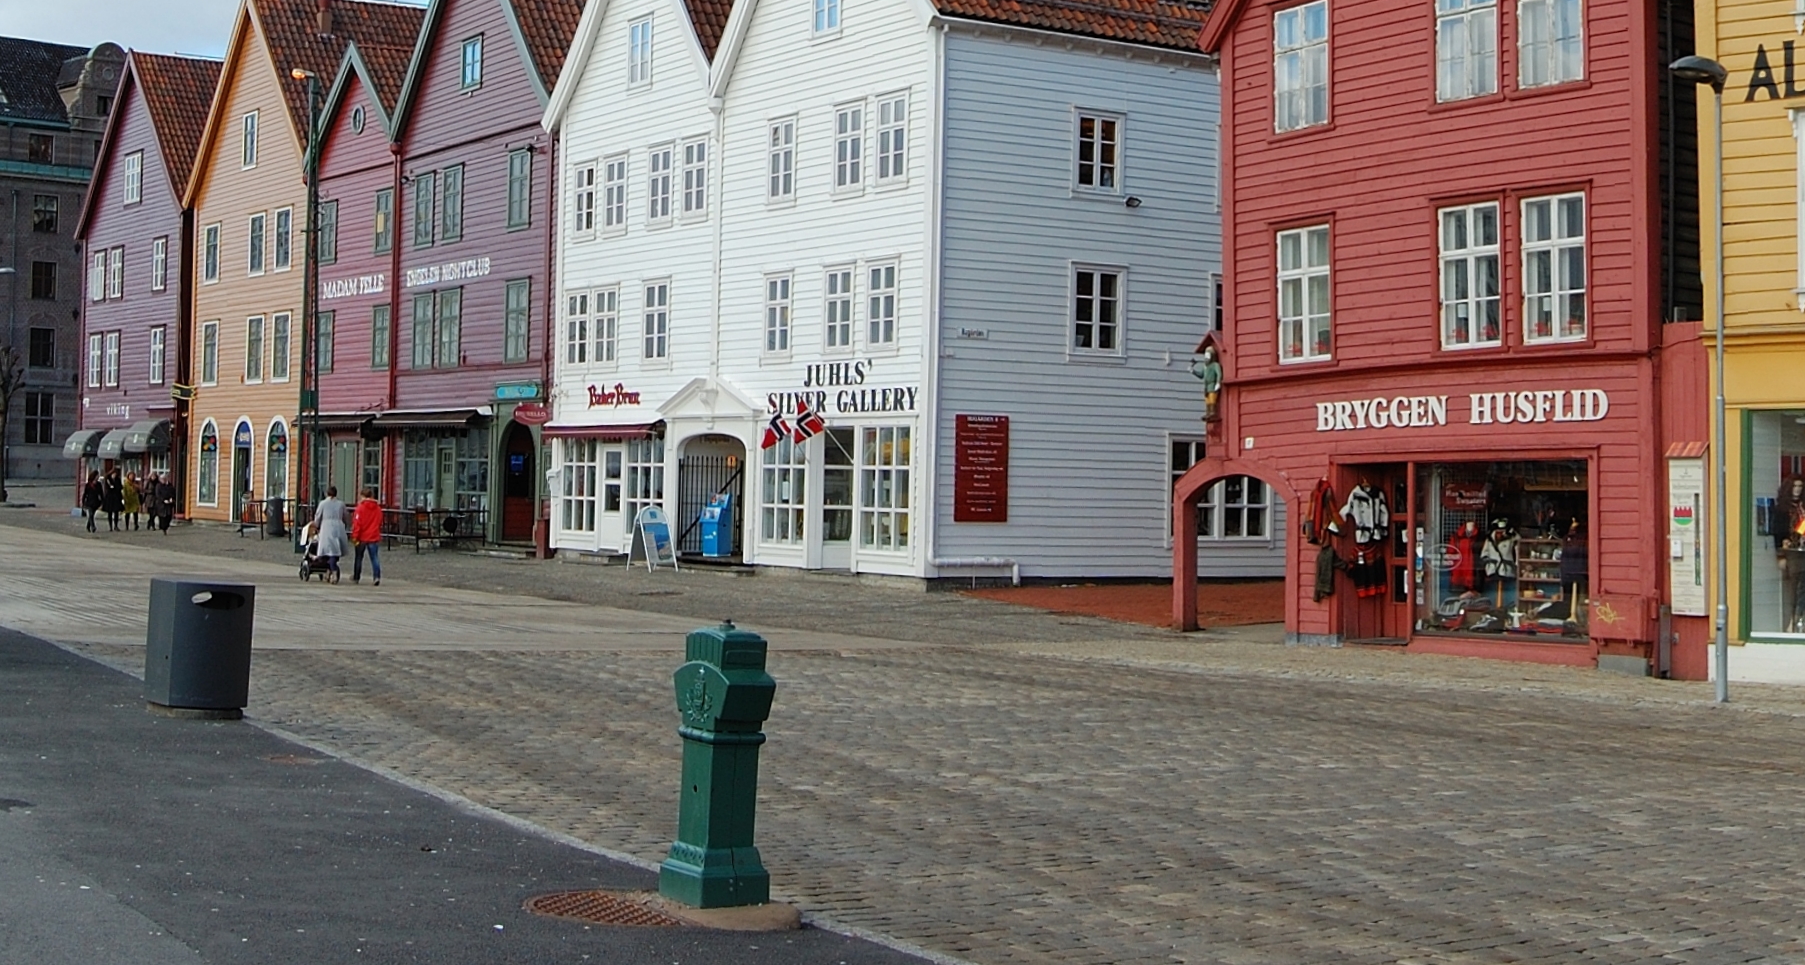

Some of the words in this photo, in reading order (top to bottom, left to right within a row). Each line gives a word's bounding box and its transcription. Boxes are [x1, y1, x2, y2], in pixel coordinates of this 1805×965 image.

[323, 278, 357, 299] MADAM
[358, 273, 385, 295] FELLE
[106, 403, 130, 420] viking
[766, 389, 827, 415] SILVER
[836, 386, 918, 414] GALLERY
[1316, 395, 1448, 432] BRYGGEN
[1469, 389, 1609, 425] HUSFLID
